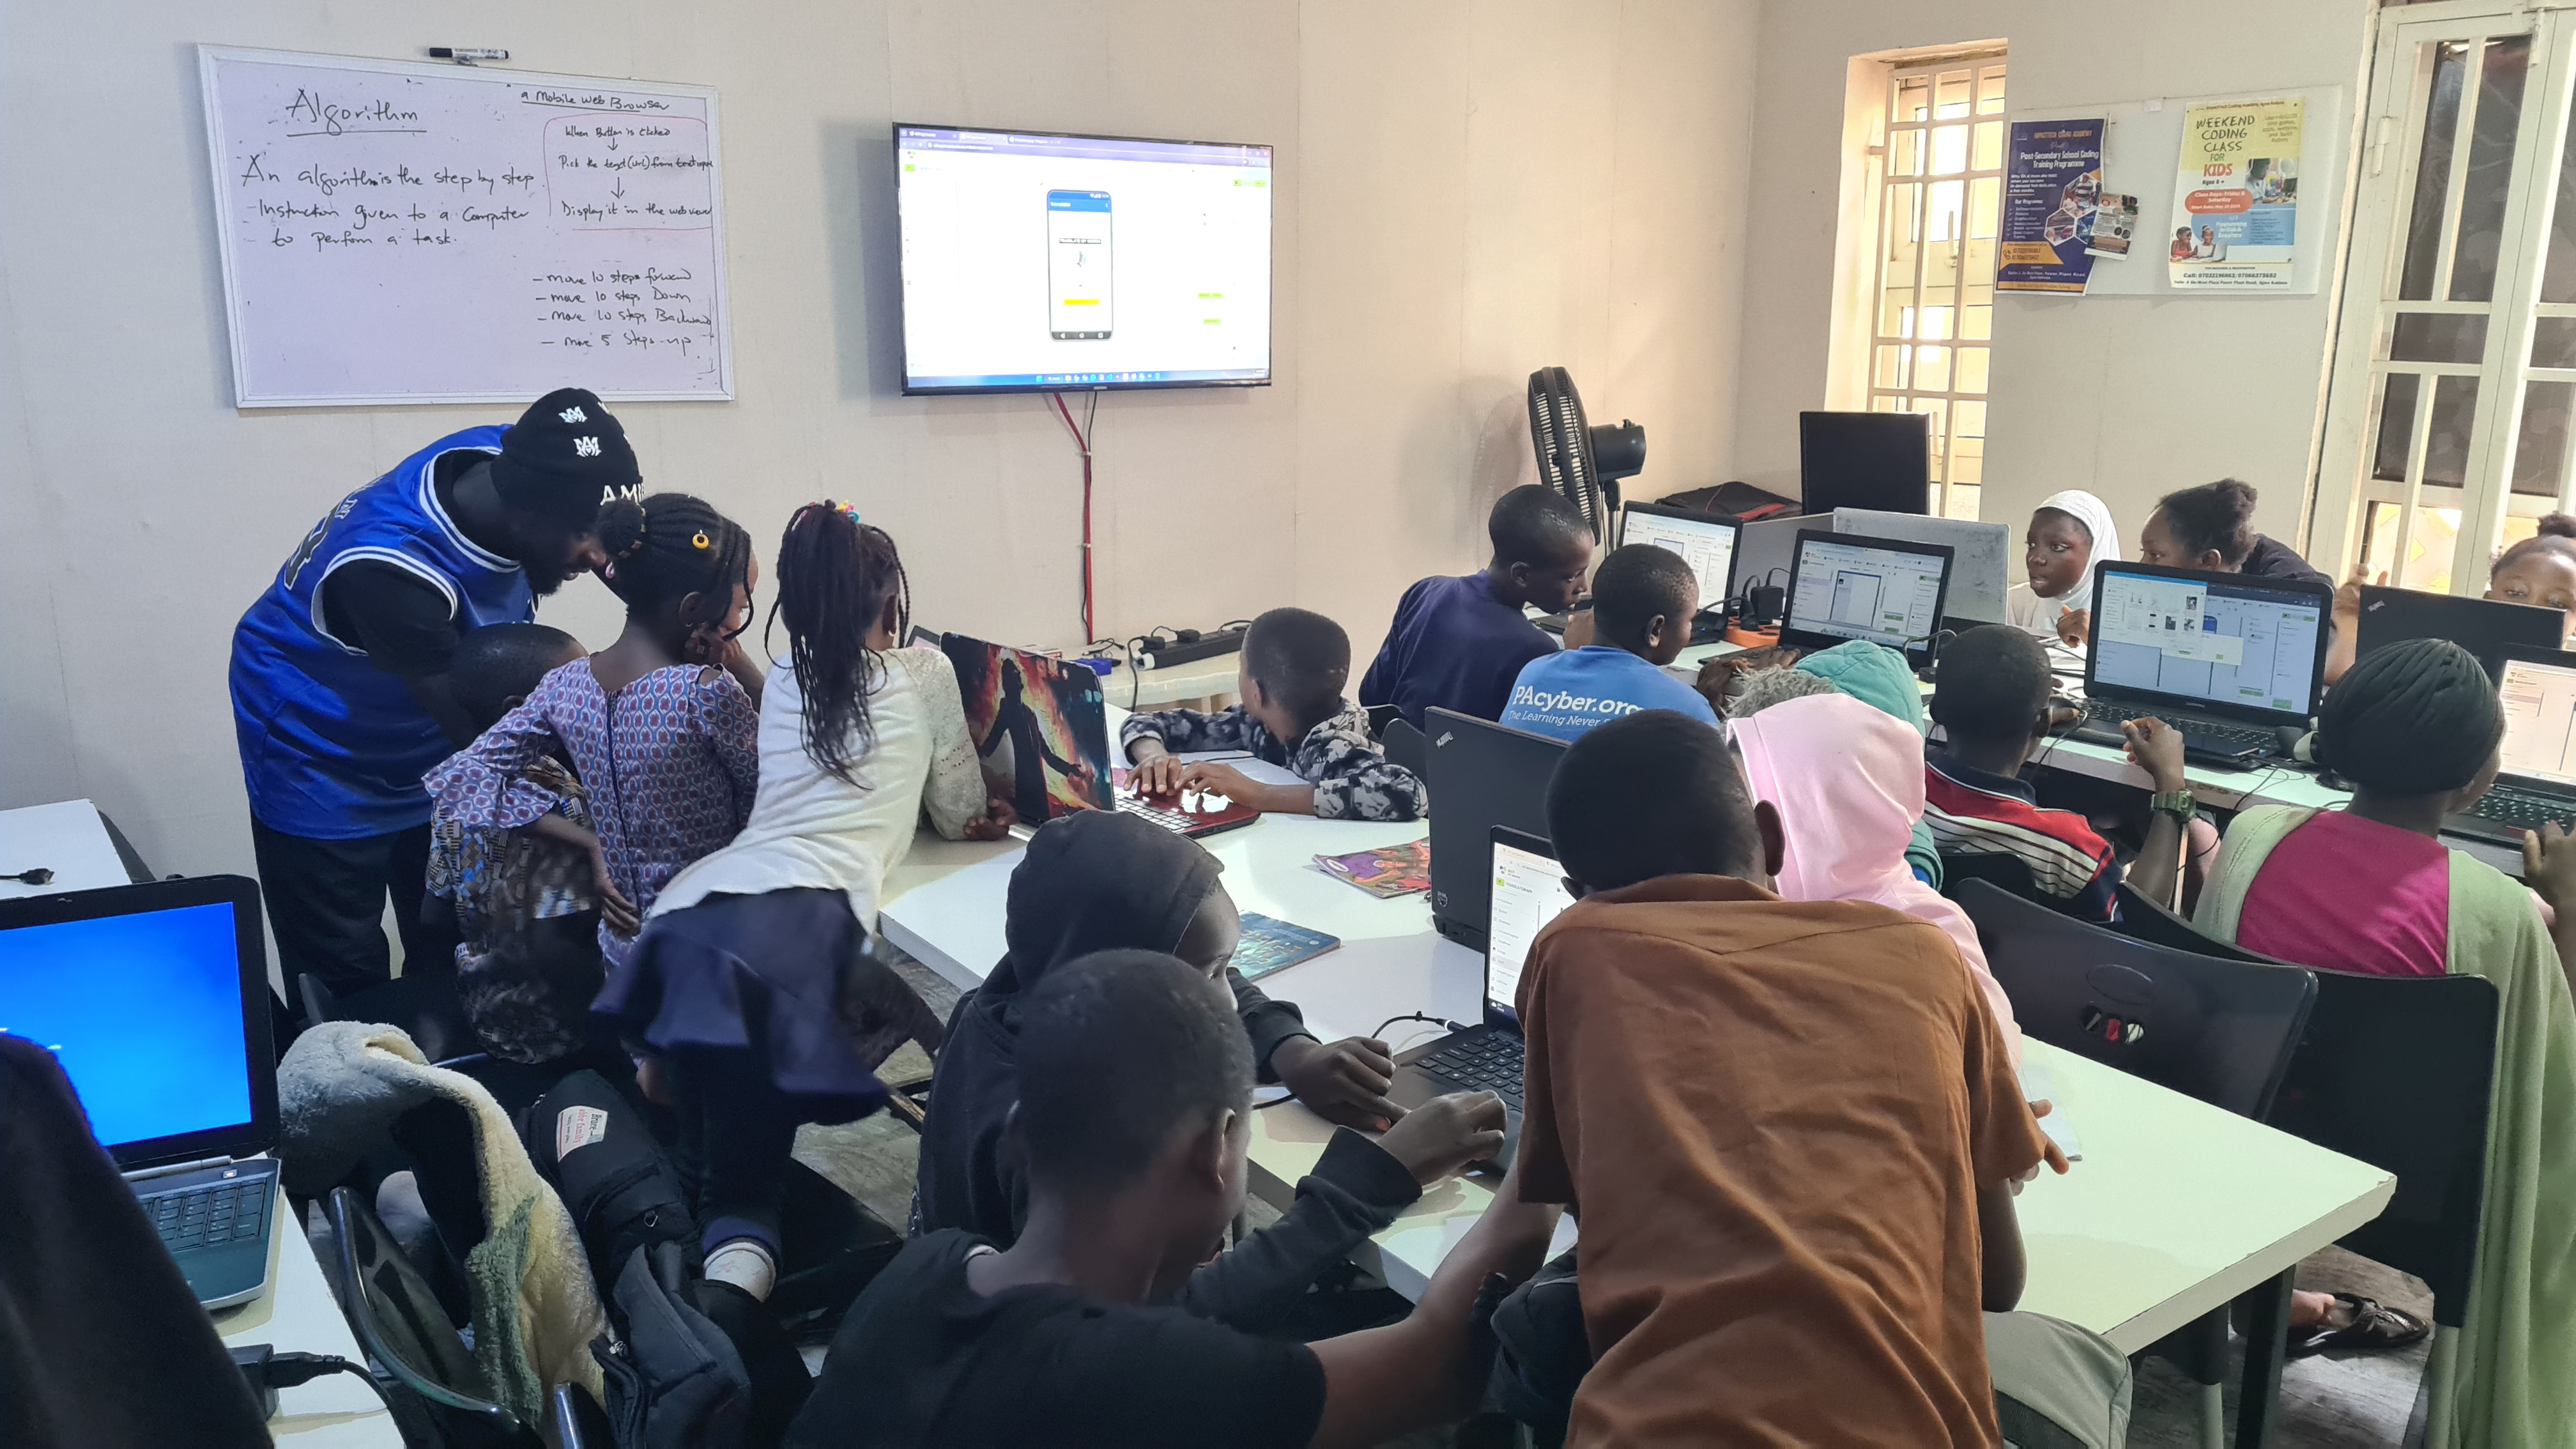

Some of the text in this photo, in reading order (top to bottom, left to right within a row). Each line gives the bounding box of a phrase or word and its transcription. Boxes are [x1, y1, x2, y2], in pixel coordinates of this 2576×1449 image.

[536, 91, 576, 104] Mobile
[611, 97, 670, 111] Browser
[286, 88, 417, 135] Algorithm
[2196, 115, 2255, 129] WEEKEND
[625, 127, 634, 136] is
[2202, 128, 2247, 140] CODING
[2204, 141, 2242, 153] CLASS
[558, 155, 579, 169] Pick
[2020, 150, 2099, 160] Post-Secondary School Coding
[2033, 161, 2053, 169] Training
[2203, 163, 2234, 177] KIDS
[241, 154, 280, 187] An
[397, 164, 424, 185] the
[434, 167, 472, 193] step
[478, 169, 494, 195] by
[502, 166, 535, 190] step
[353, 204, 399, 230] given
[407, 203, 426, 221] to
[440, 211, 449, 220] a
[562, 200, 603, 222] Display
[646, 202, 664, 215] the
[272, 228, 293, 247] to
[387, 236, 397, 245] a
[547, 273, 586, 285] move
[551, 293, 585, 303] move
[651, 286, 691, 303] Down
[1508, 710, 1521, 721] The
[1521, 710, 1566, 727] Learning
[1566, 716, 1601, 727] Never
